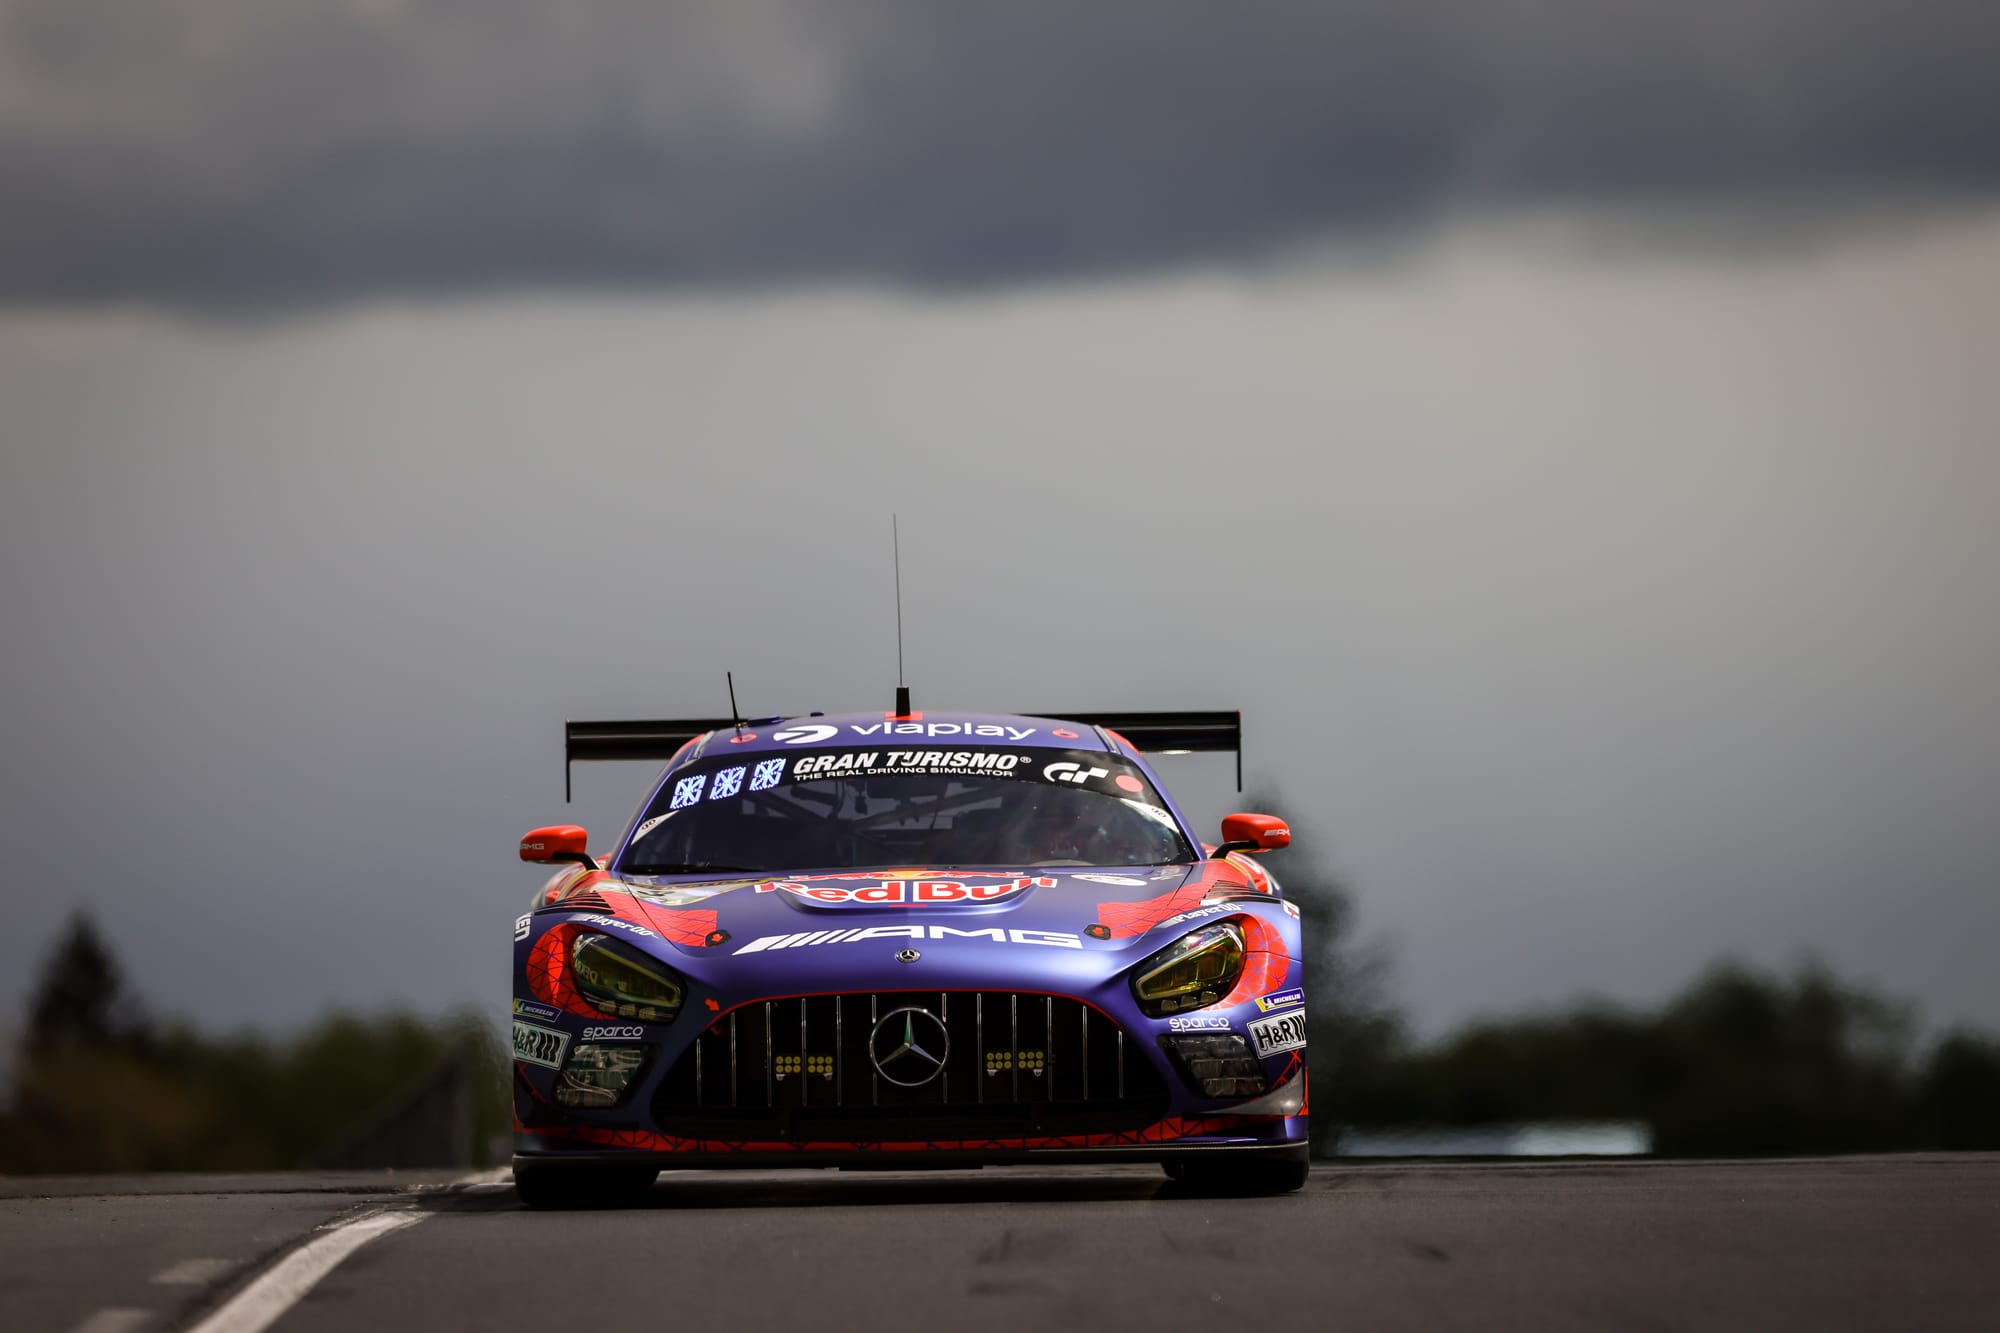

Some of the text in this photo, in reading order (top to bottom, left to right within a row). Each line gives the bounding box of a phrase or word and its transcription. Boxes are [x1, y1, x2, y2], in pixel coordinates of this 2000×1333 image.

[850, 721, 1037, 741] viaplay
[793, 752, 879, 774] GRAN
[794, 766, 1014, 781] THE REAL DRIVING SIMULATOR
[754, 881, 905, 903] Red
[912, 876, 1058, 902] Bull
[842, 925, 1083, 949] AMG
[1273, 993, 1301, 1004] MICHELIN
[524, 1006, 555, 1017] MICHELIN
[581, 1025, 644, 1041] sparco
[1169, 1016, 1231, 1033] sparco
